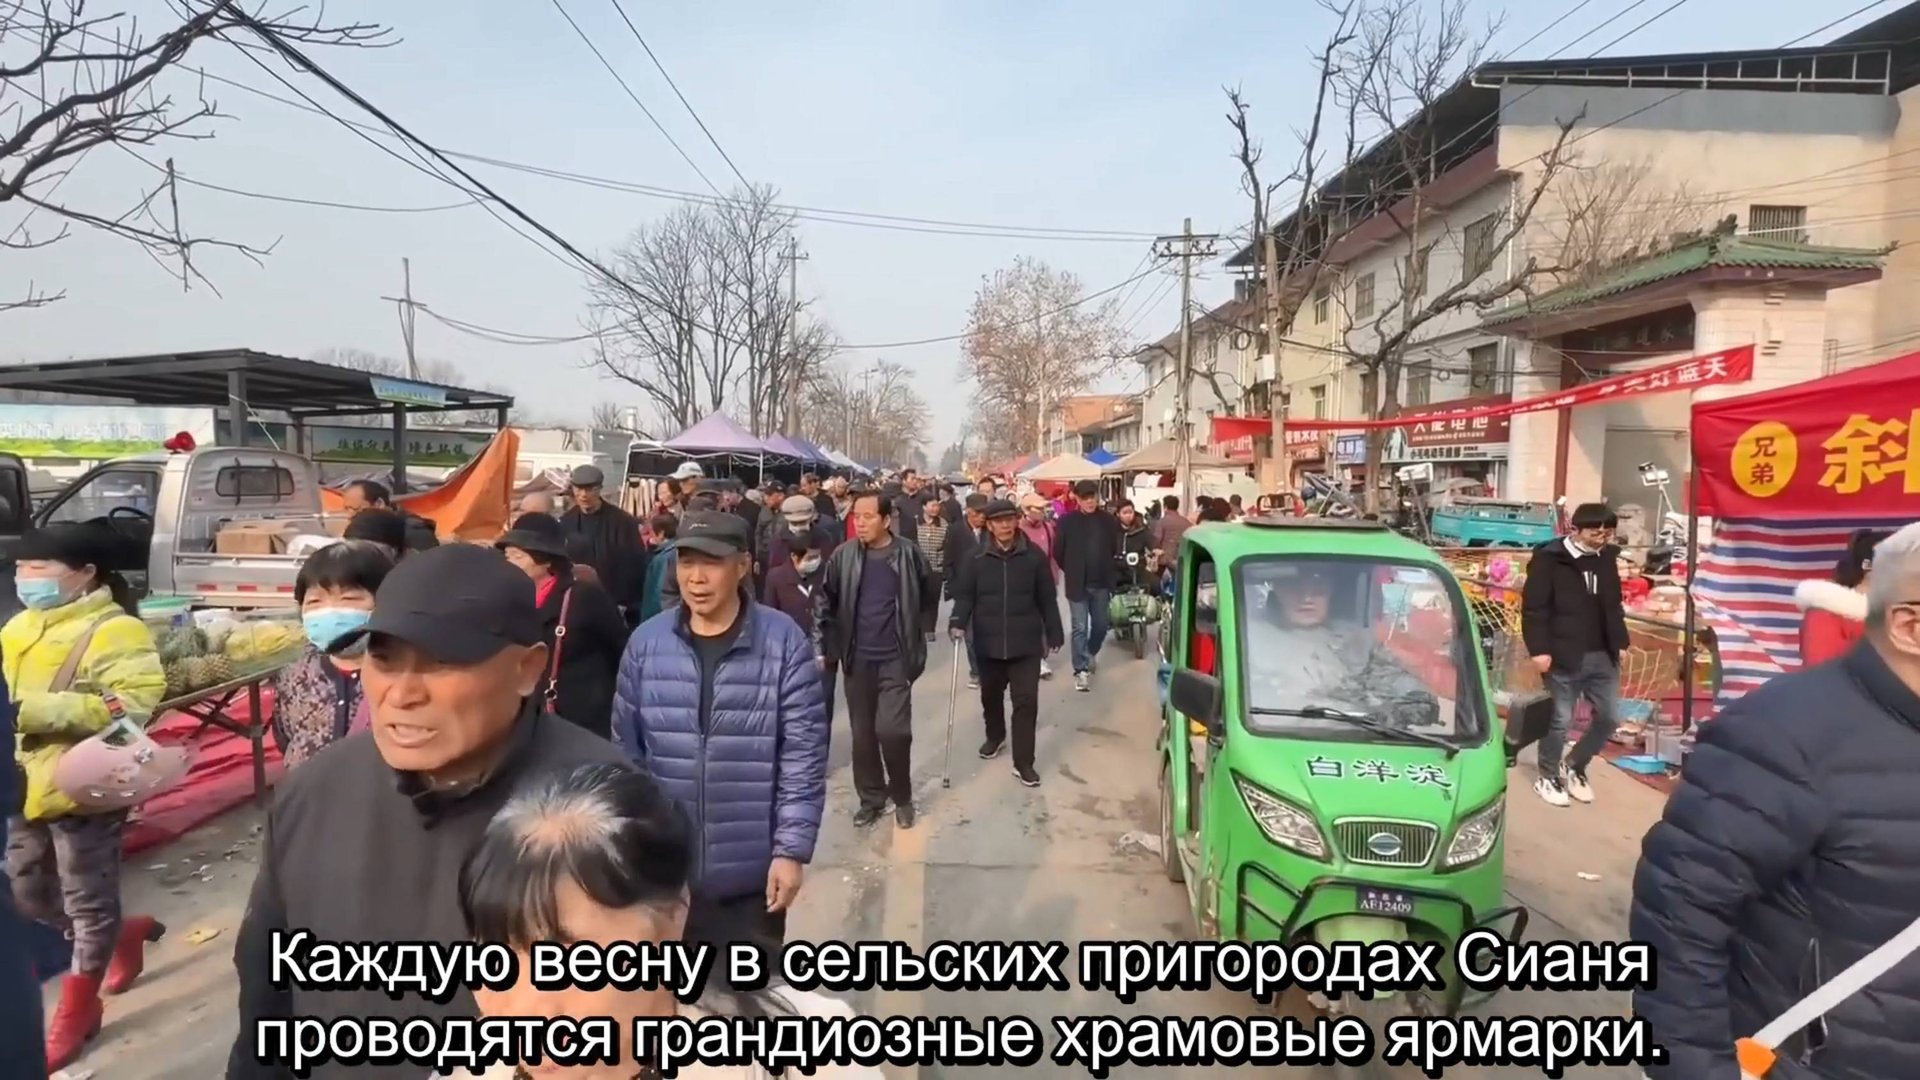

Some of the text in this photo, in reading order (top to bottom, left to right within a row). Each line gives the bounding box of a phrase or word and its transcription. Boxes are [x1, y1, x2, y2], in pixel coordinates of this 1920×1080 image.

[1750, 436, 1777, 486] 兄弟
[1306, 756, 1453, 789] 白洋淀
